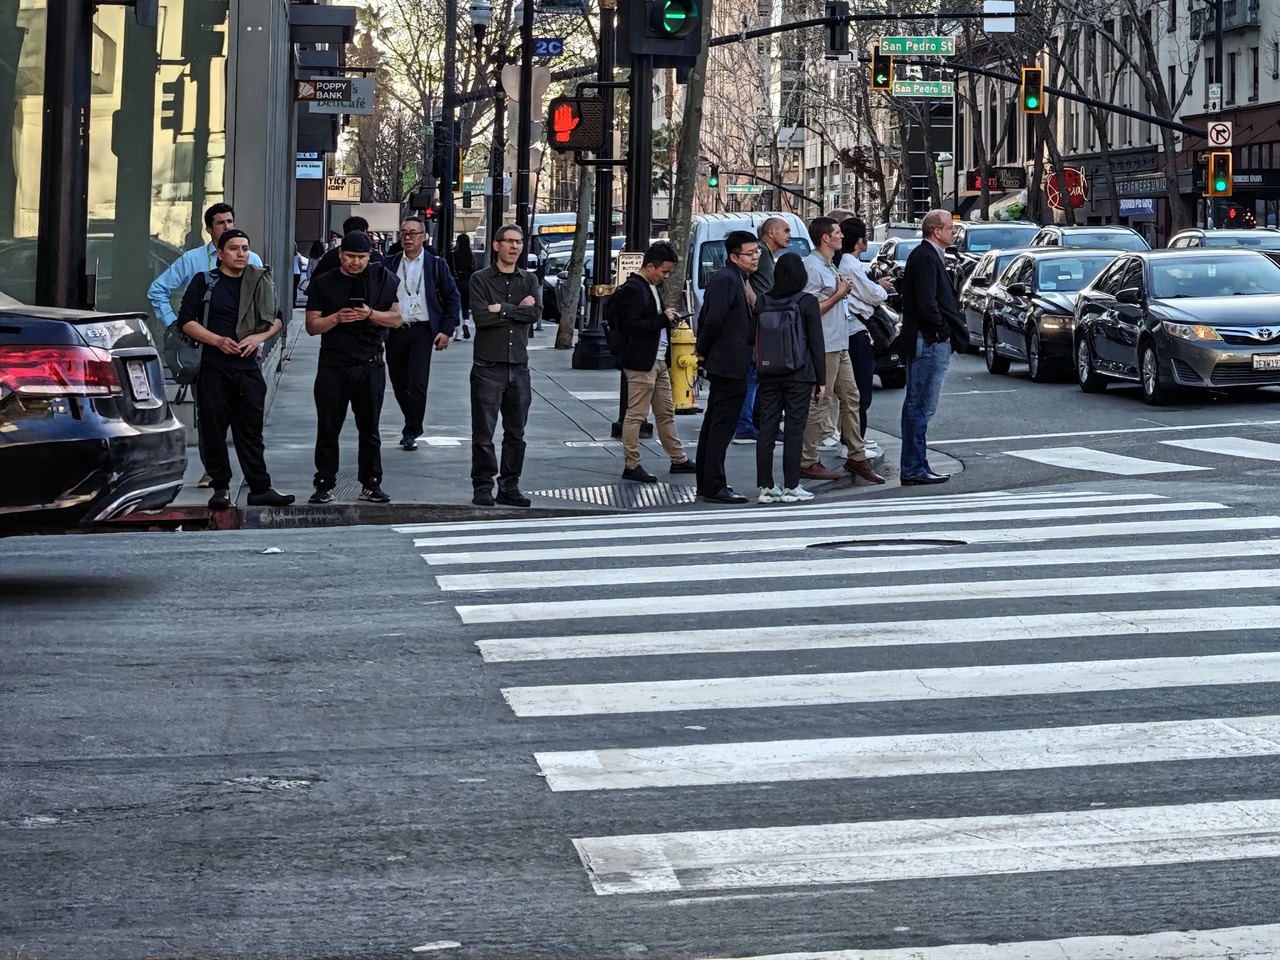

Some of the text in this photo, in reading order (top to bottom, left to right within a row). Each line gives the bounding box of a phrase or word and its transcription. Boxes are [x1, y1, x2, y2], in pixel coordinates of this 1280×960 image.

[536, 41, 561, 54] 2C
[883, 41, 953, 51] San Pedro St
[316, 82, 347, 90] POPPY
[895, 84, 951, 93] San Pedro St
[88, 329, 108, 337] E350
